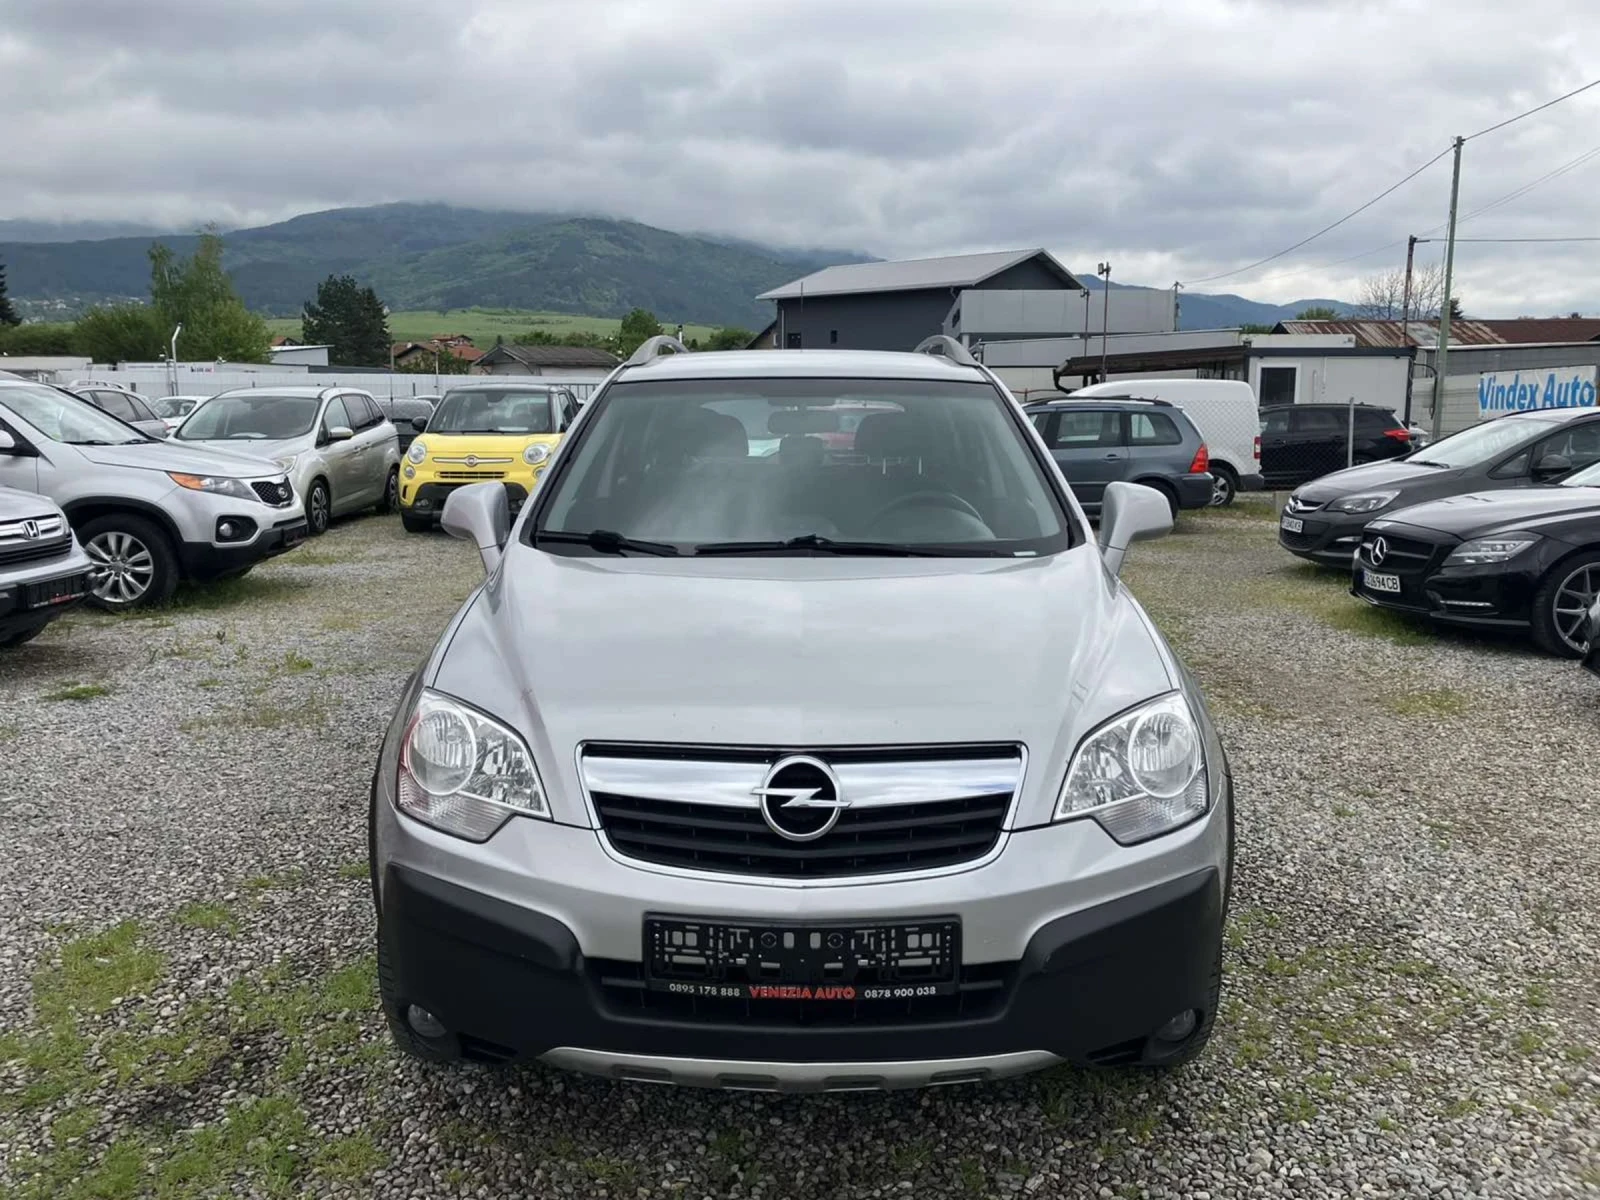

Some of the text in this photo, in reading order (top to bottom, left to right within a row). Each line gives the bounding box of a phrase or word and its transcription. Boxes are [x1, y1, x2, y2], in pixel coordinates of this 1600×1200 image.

[1479, 373, 1596, 411] Vindex Auto
[669, 983, 937, 1000] 0895 178 888 VENEZIA AUTO 0878 900 038
